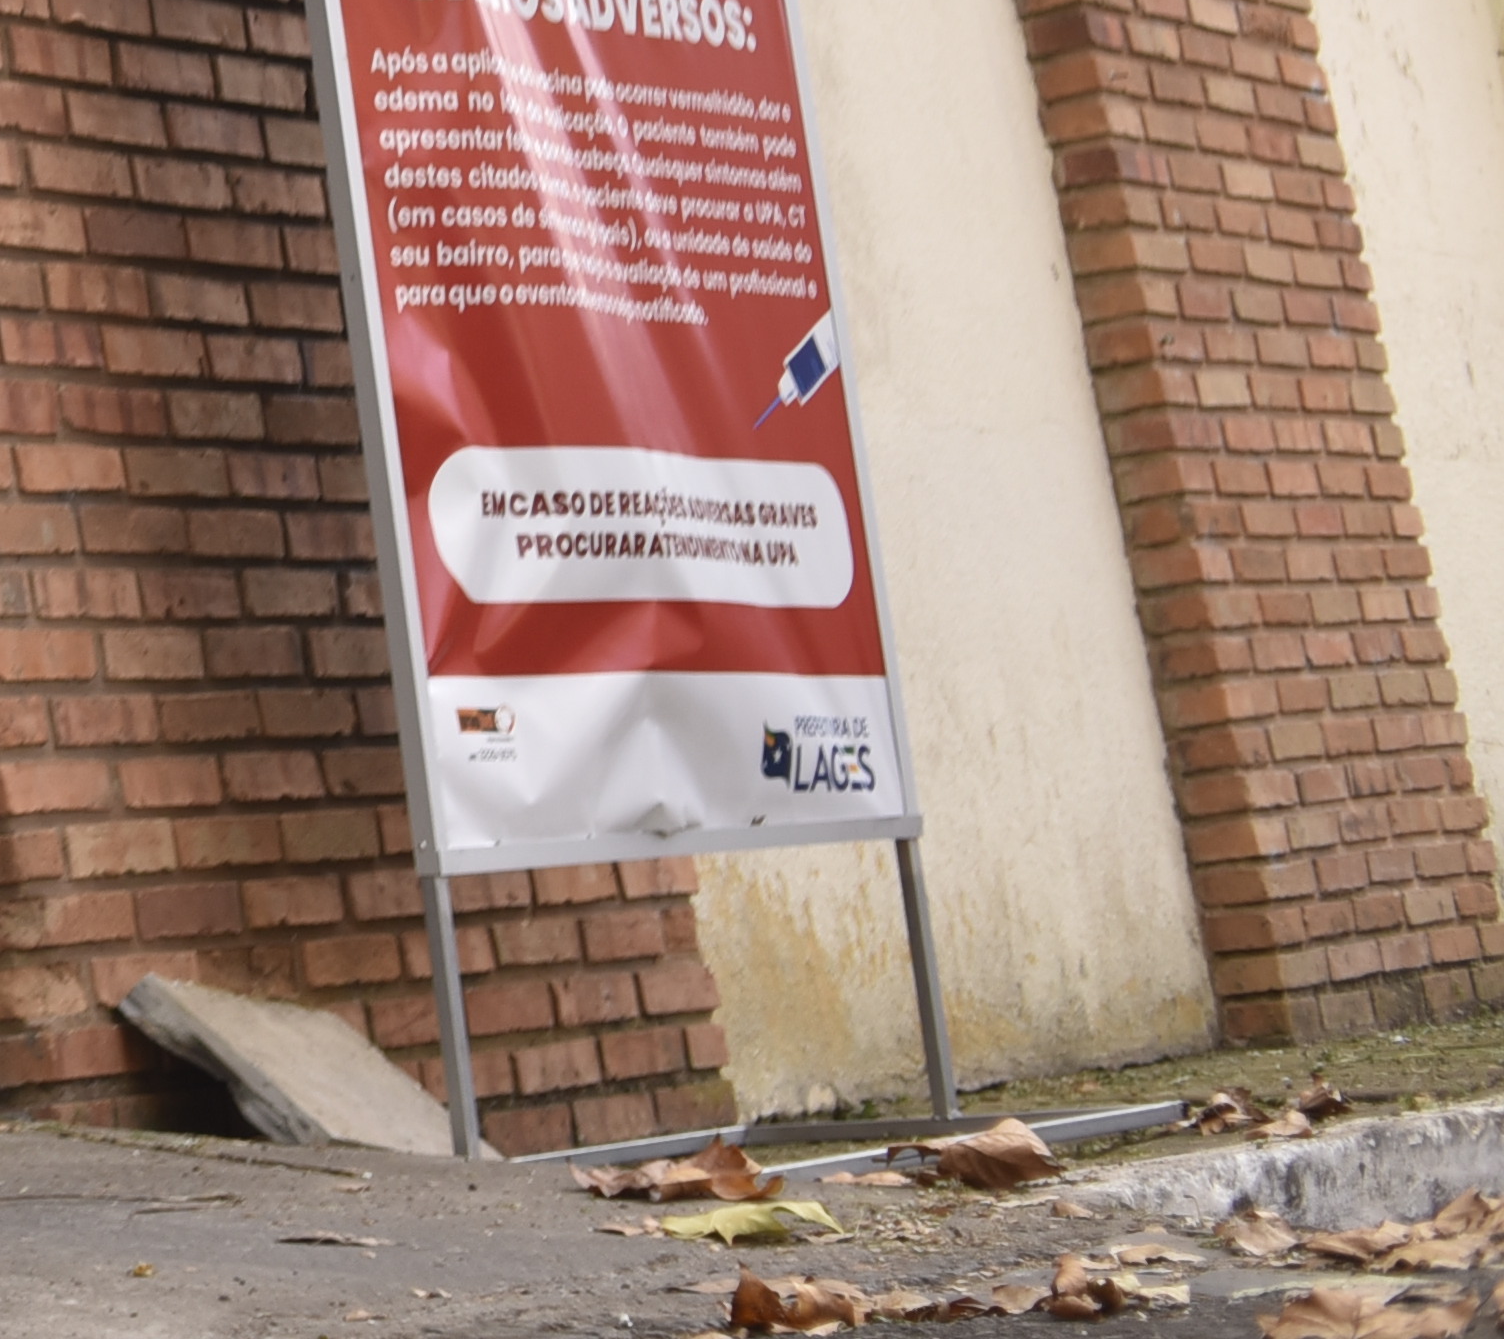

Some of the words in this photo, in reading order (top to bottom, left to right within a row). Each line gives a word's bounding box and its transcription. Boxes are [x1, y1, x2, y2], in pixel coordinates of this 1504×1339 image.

[371, 46, 428, 81] Após
[433, 52, 448, 73] a
[375, 86, 458, 113] edema
[468, 89, 494, 113] no
[380, 125, 504, 157] apresentar
[384, 165, 462, 190] destes
[388, 199, 435, 233] (em
[441, 203, 507, 229] casos
[512, 207, 535, 229] de
[391, 243, 430, 267] seu
[437, 237, 514, 270] bairro,
[519, 248, 561, 276] para
[395, 280, 442, 313] para
[449, 282, 496, 313] que
[499, 283, 514, 306] o
[481, 490, 507, 518] EM
[509, 491, 585, 518] CASO
[590, 489, 616, 517] DE
[758, 499, 818, 529] GRAVES
[516, 532, 647, 561] PROCURAR
[767, 540, 799, 567] UPA
[793, 743, 876, 793] LAGES
